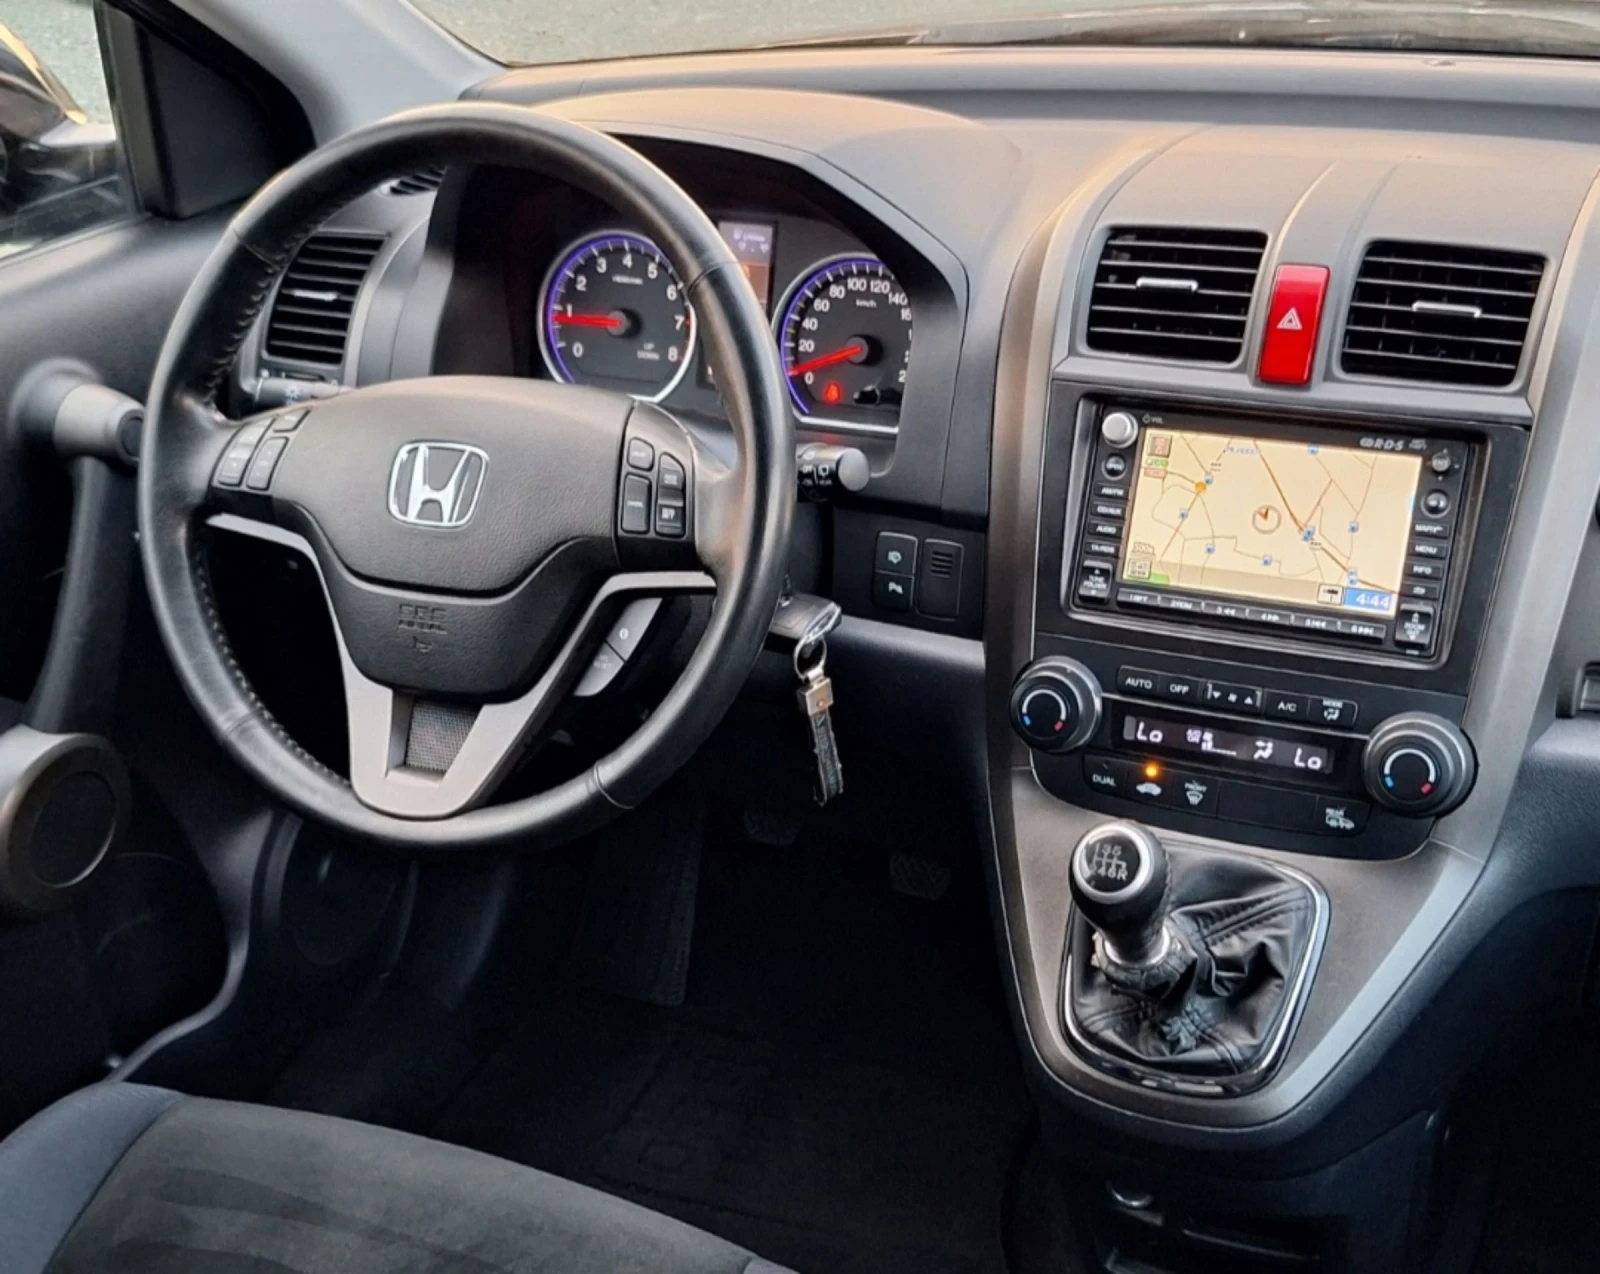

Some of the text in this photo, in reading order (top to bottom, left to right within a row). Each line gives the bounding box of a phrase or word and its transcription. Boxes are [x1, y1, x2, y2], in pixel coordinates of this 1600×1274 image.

[596, 257, 607, 273] 3
[622, 253, 633, 268] 4
[647, 262, 658, 279] 5
[575, 275, 587, 292] 2
[847, 278, 867, 291] 100
[870, 280, 890, 293] 120
[666, 284, 677, 301] 6
[829, 284, 845, 299] 80
[888, 291, 908, 306] 140
[566, 303, 573, 318] 1
[813, 299, 830, 312] 60
[901, 308, 912, 321] 16
[674, 314, 685, 331] 7
[801, 318, 818, 331] 40
[572, 342, 583, 358] 0
[667, 346, 678, 362] 8
[798, 340, 815, 353] 20
[804, 371, 814, 385] 0
[1415, 544, 1438, 554] MENU
[1355, 592, 1391, 609] 4:44
[1125, 676, 1153, 689] AUTO
[1169, 683, 1190, 695] OFF
[1278, 701, 1297, 712] A/C
[1136, 721, 1163, 743] Lo
[1294, 747, 1322, 770] Lo
[1092, 773, 1116, 787] DUAL
